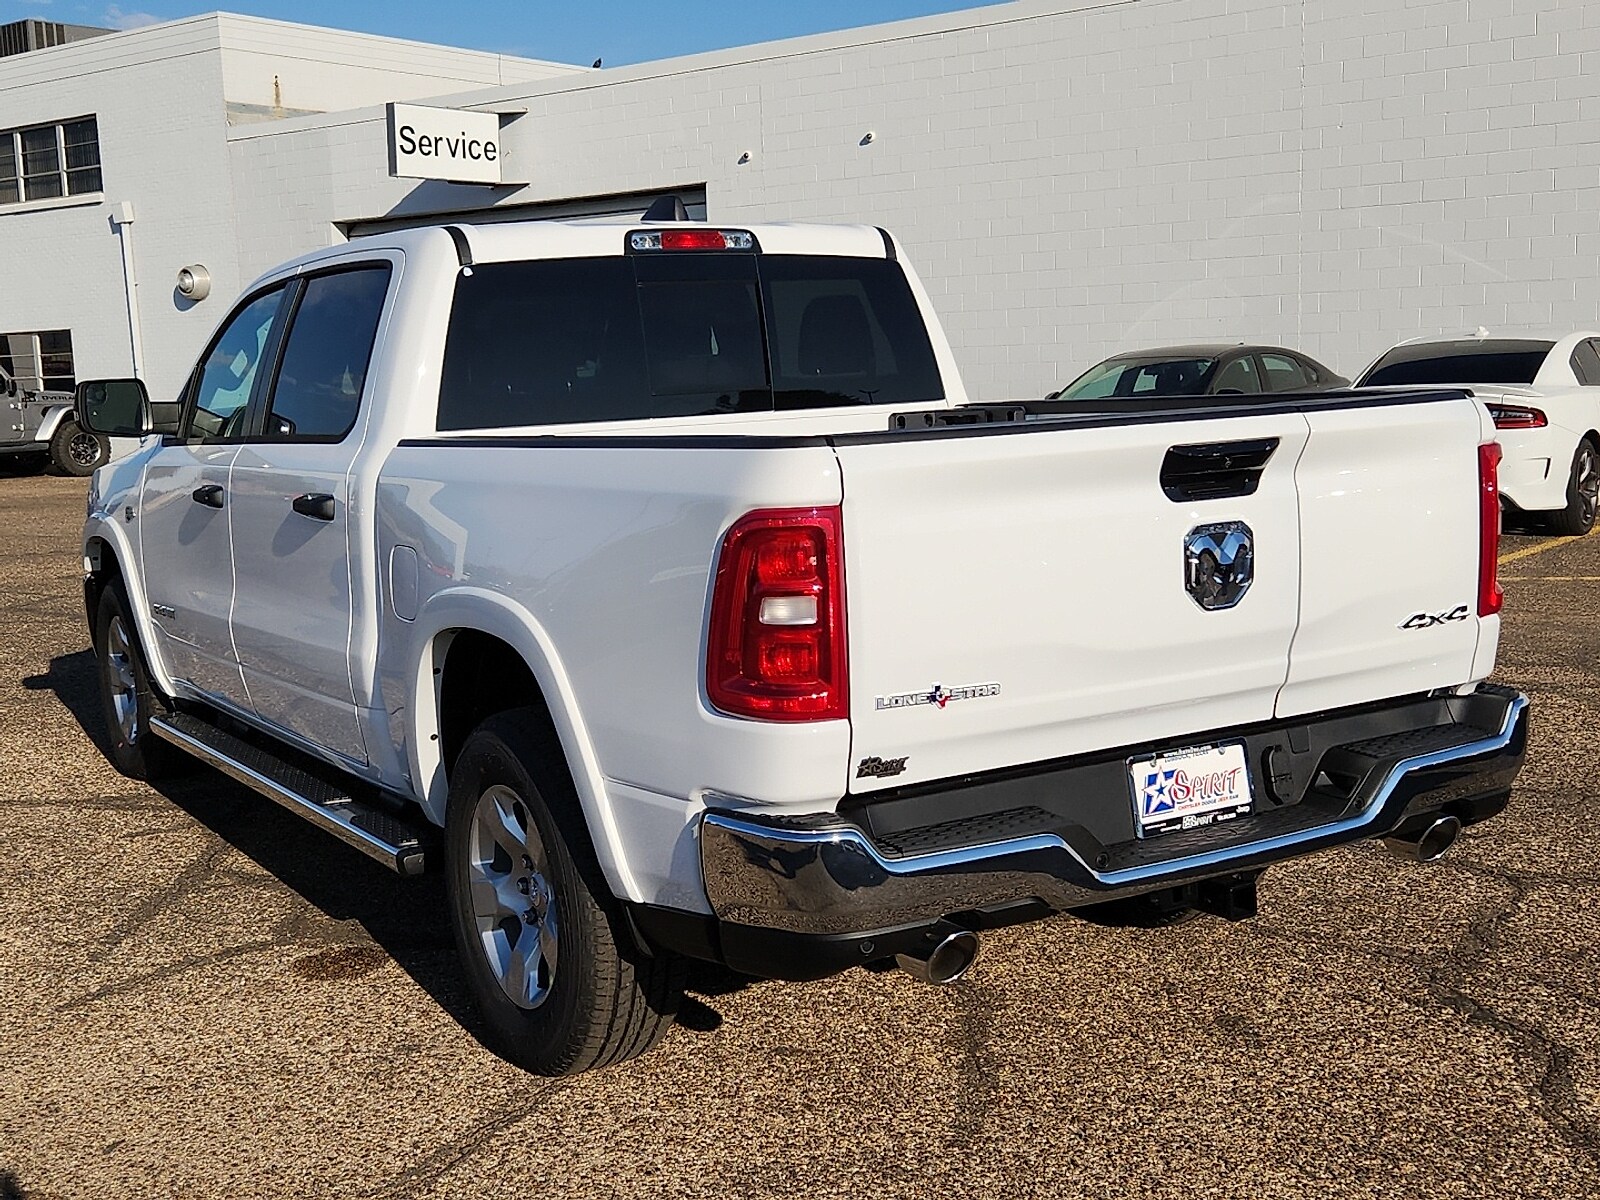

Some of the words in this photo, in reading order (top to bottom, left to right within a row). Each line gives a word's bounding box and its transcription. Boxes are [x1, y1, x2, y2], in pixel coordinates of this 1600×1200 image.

[399, 125, 497, 161] Service
[875, 692, 930, 711] LONE
[950, 683, 1001, 701] STAR
